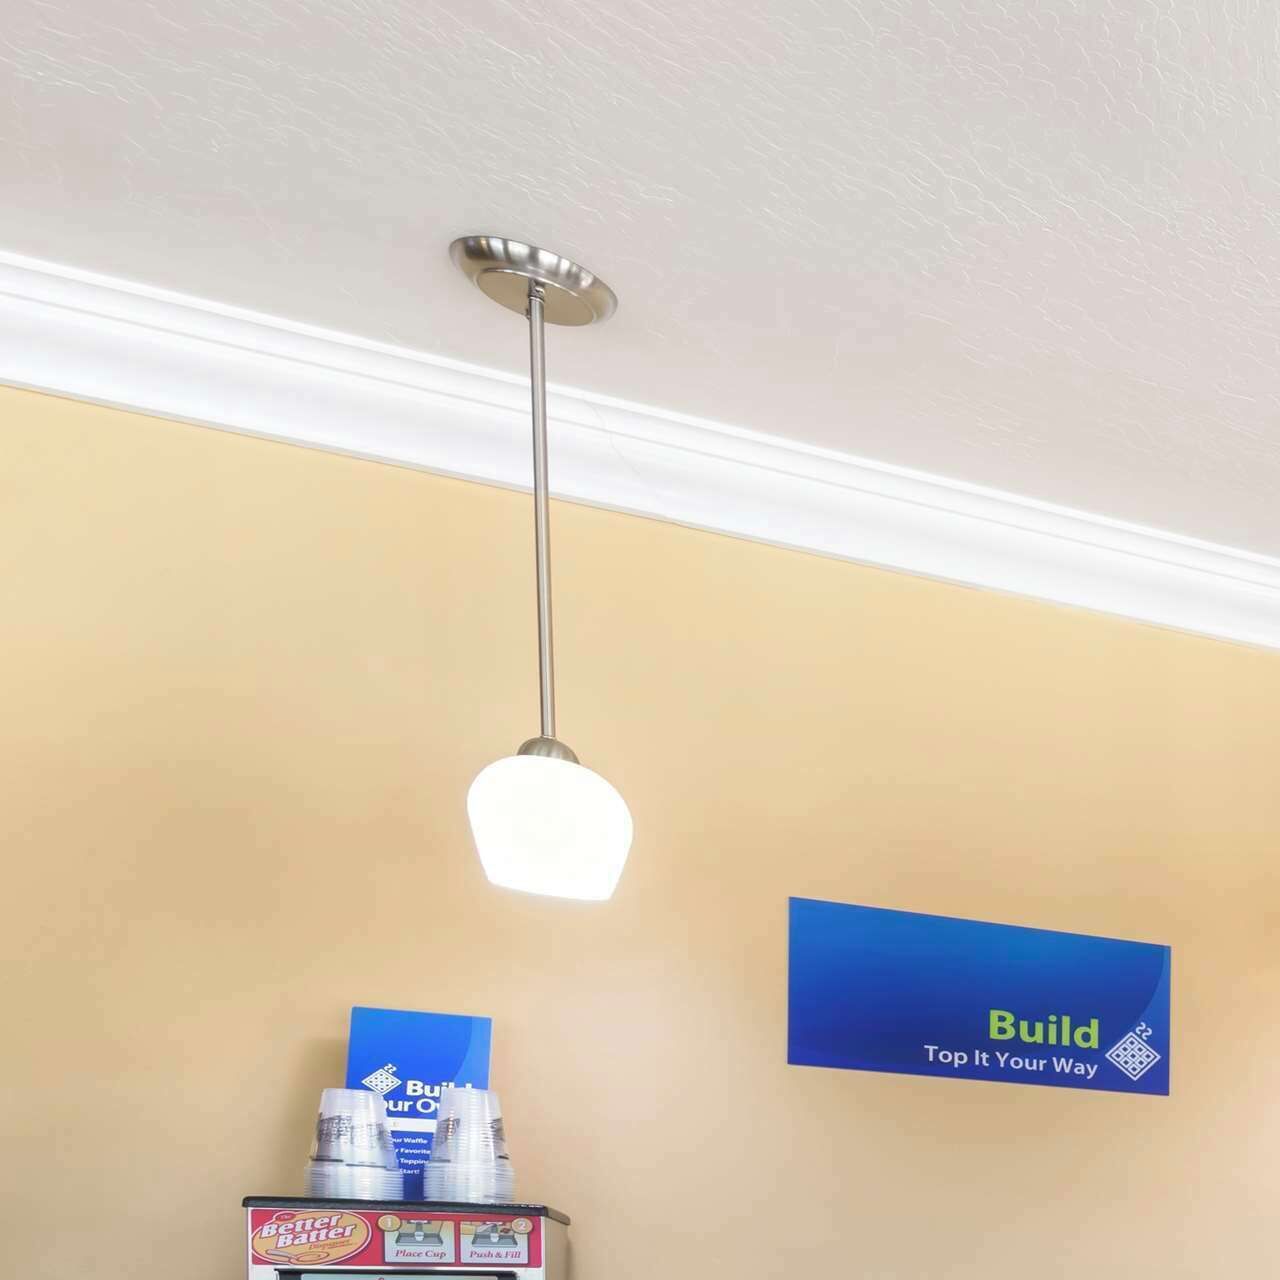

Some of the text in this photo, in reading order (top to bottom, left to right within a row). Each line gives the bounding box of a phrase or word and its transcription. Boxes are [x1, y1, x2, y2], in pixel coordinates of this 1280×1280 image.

[989, 1009, 1099, 1049] Build
[924, 1045, 1098, 1080] Top It Your Way
[261, 1214, 341, 1238] Better
[277, 1225, 355, 1248] Batter
[395, 1250, 446, 1259] Place Cup
[469, 1250, 493, 1258] Push
